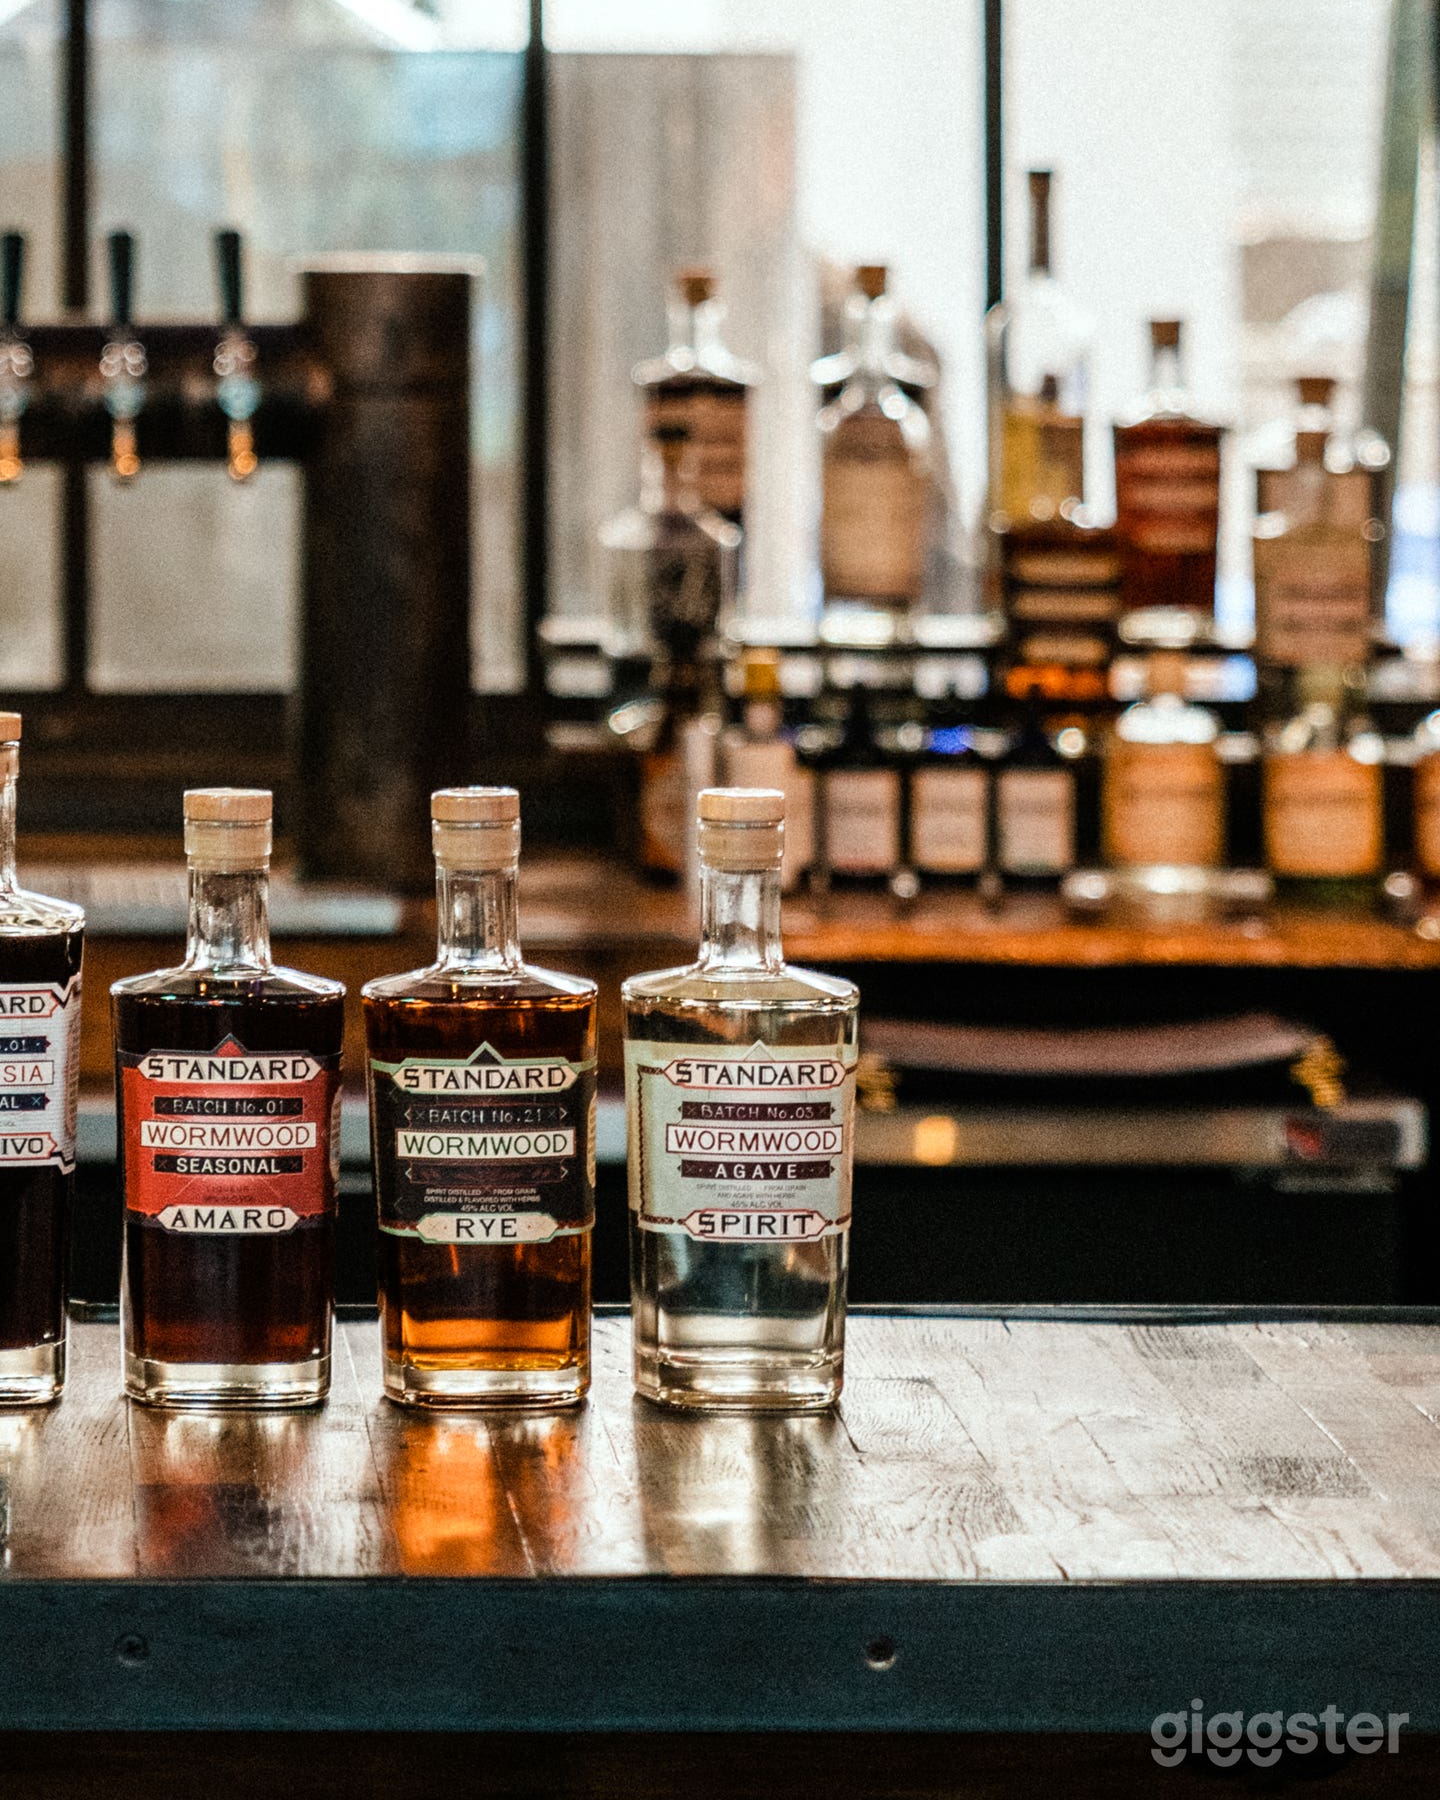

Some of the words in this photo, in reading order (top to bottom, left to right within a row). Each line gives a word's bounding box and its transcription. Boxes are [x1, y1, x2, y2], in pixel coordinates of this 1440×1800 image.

[148, 1058, 310, 1080] STANDARD
[404, 1067, 566, 1089] STANDARD
[676, 1063, 838, 1086] STANDARD
[173, 1099, 227, 1114] BATCH
[429, 1109, 484, 1123] BATCH
[701, 1105, 760, 1119] BATCH
[147, 1125, 310, 1146] WORMWOOD
[404, 1134, 567, 1155] WORMWOOD
[674, 1129, 837, 1151] WORMWOOD
[176, 1158, 281, 1174] SEASONAL
[715, 1163, 798, 1179] AGAVE
[171, 1209, 286, 1228] AMARO
[456, 1218, 518, 1238] RYE
[699, 1213, 813, 1236] SPIRIT
